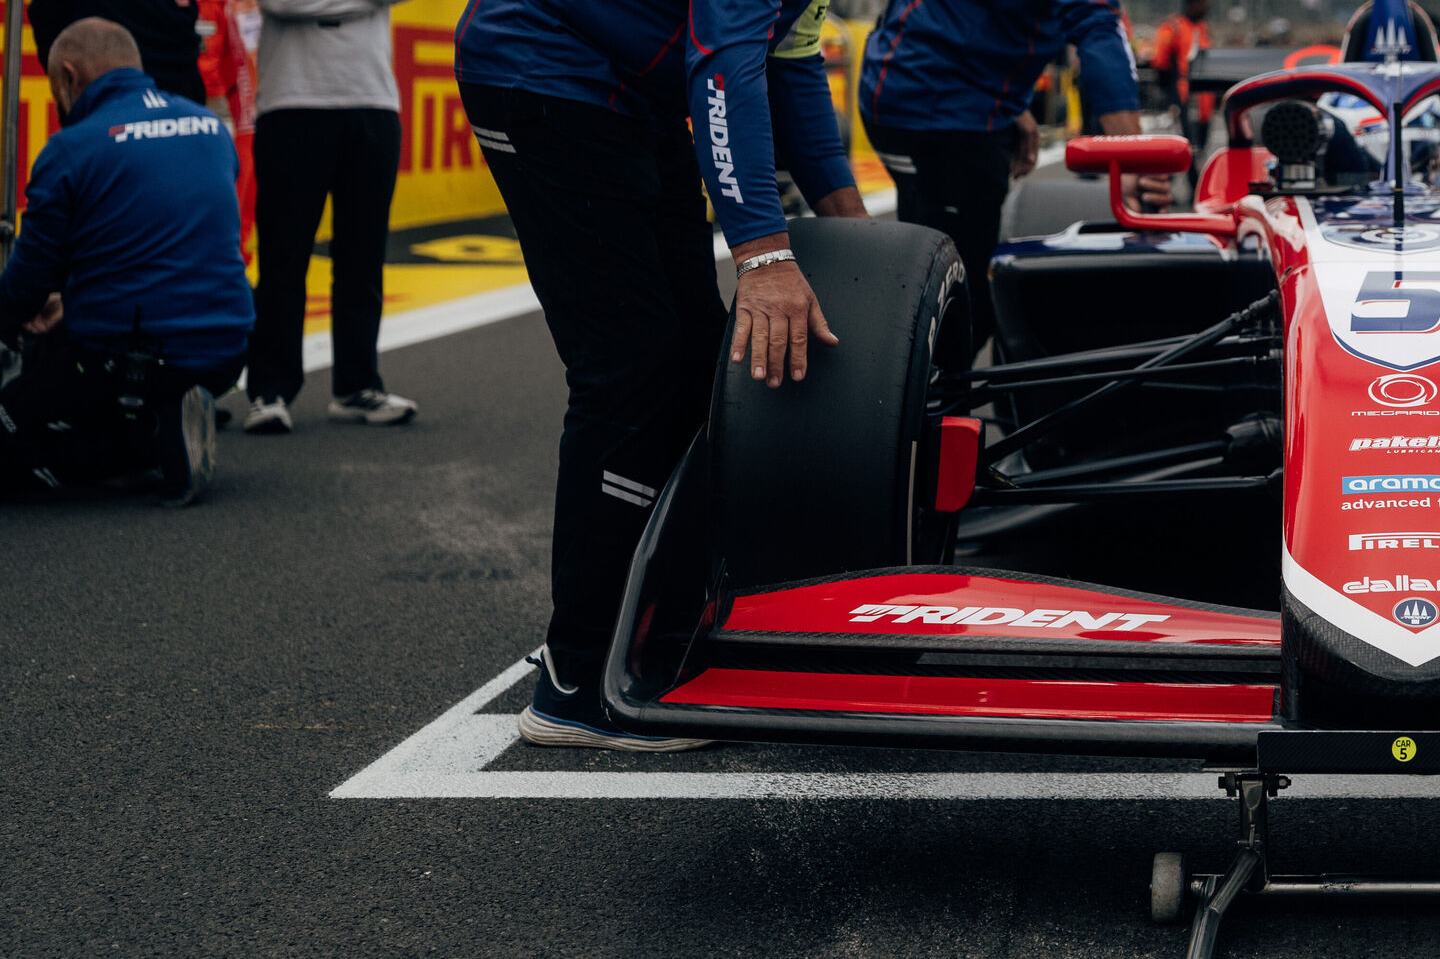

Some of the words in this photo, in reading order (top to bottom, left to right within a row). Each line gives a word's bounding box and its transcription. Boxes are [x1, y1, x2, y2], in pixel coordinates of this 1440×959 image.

[108, 115, 219, 143] TRIDENT
[708, 72, 744, 204] TRIDENT
[1341, 497, 1431, 510] advanced
[849, 603, 1172, 631] TRIDENT
[1399, 747, 1407, 760] 5
